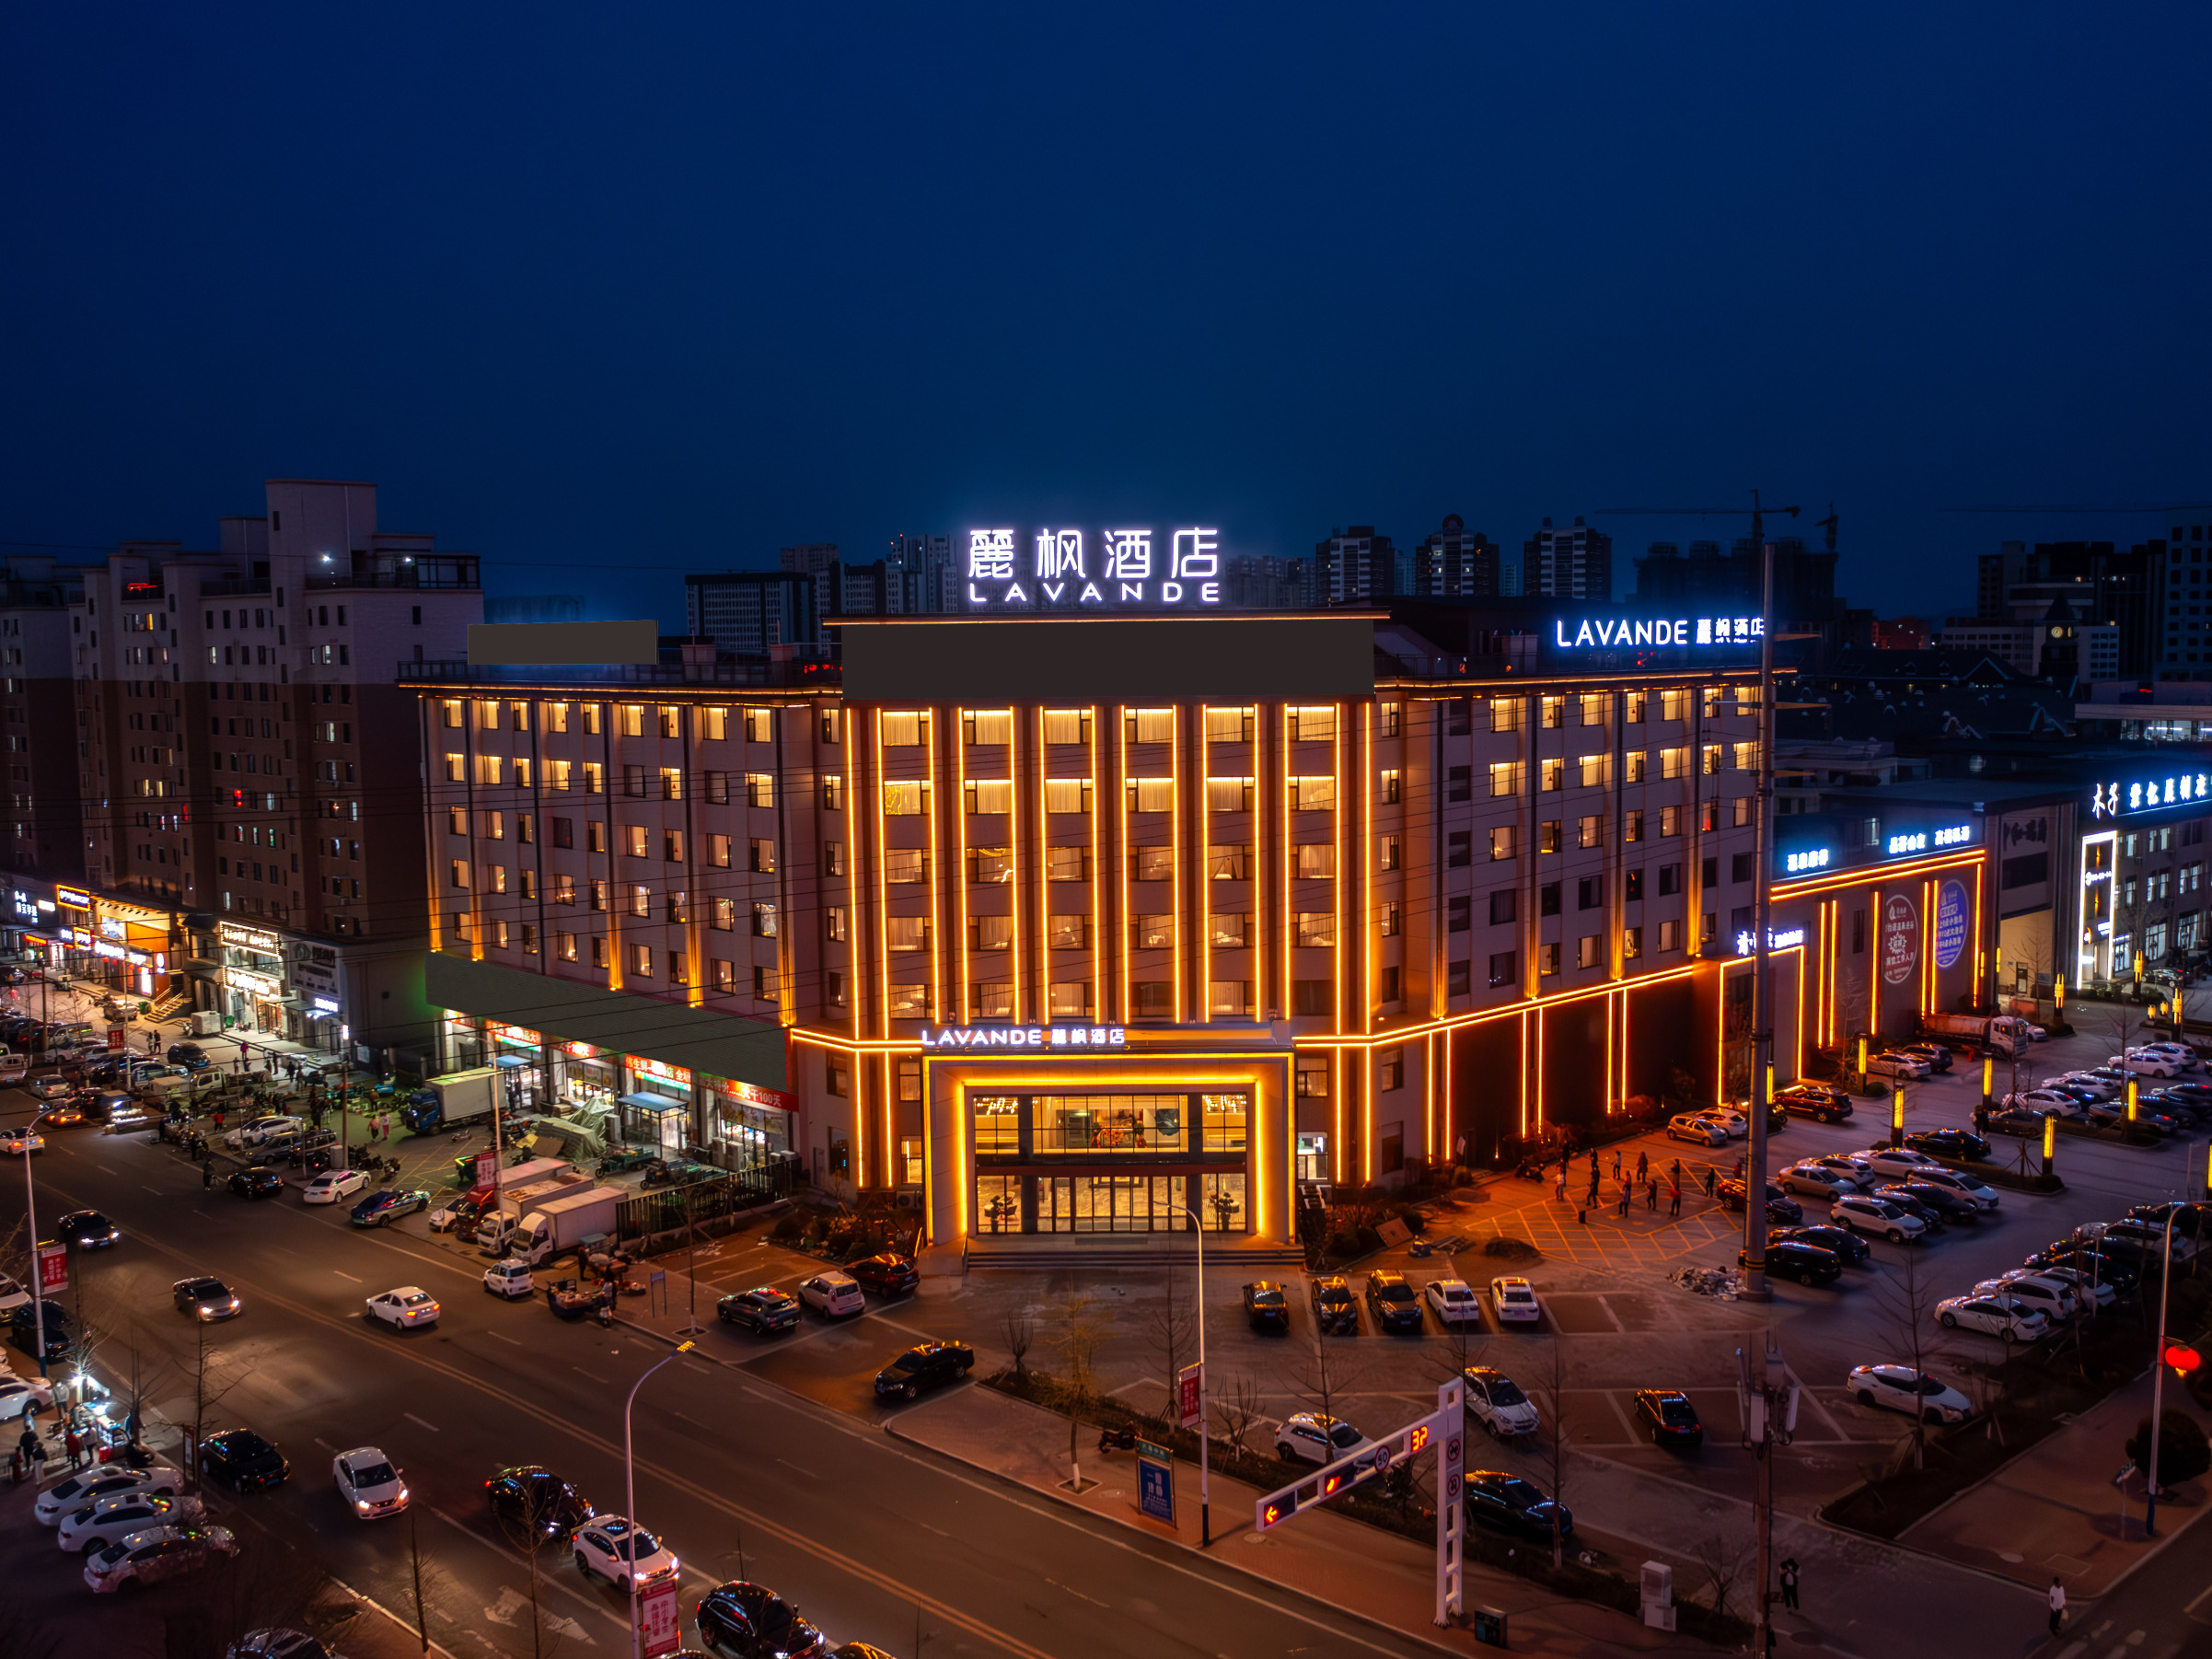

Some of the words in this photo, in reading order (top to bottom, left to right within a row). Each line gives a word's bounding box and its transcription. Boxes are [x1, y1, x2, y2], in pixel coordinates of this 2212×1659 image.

[968, 528, 1218, 579] 麗枫酒店
[969, 582, 1220, 602] LAVANDE
[1557, 619, 1688, 646] LAVANDE
[921, 1029, 1041, 1046] LAVANDE
